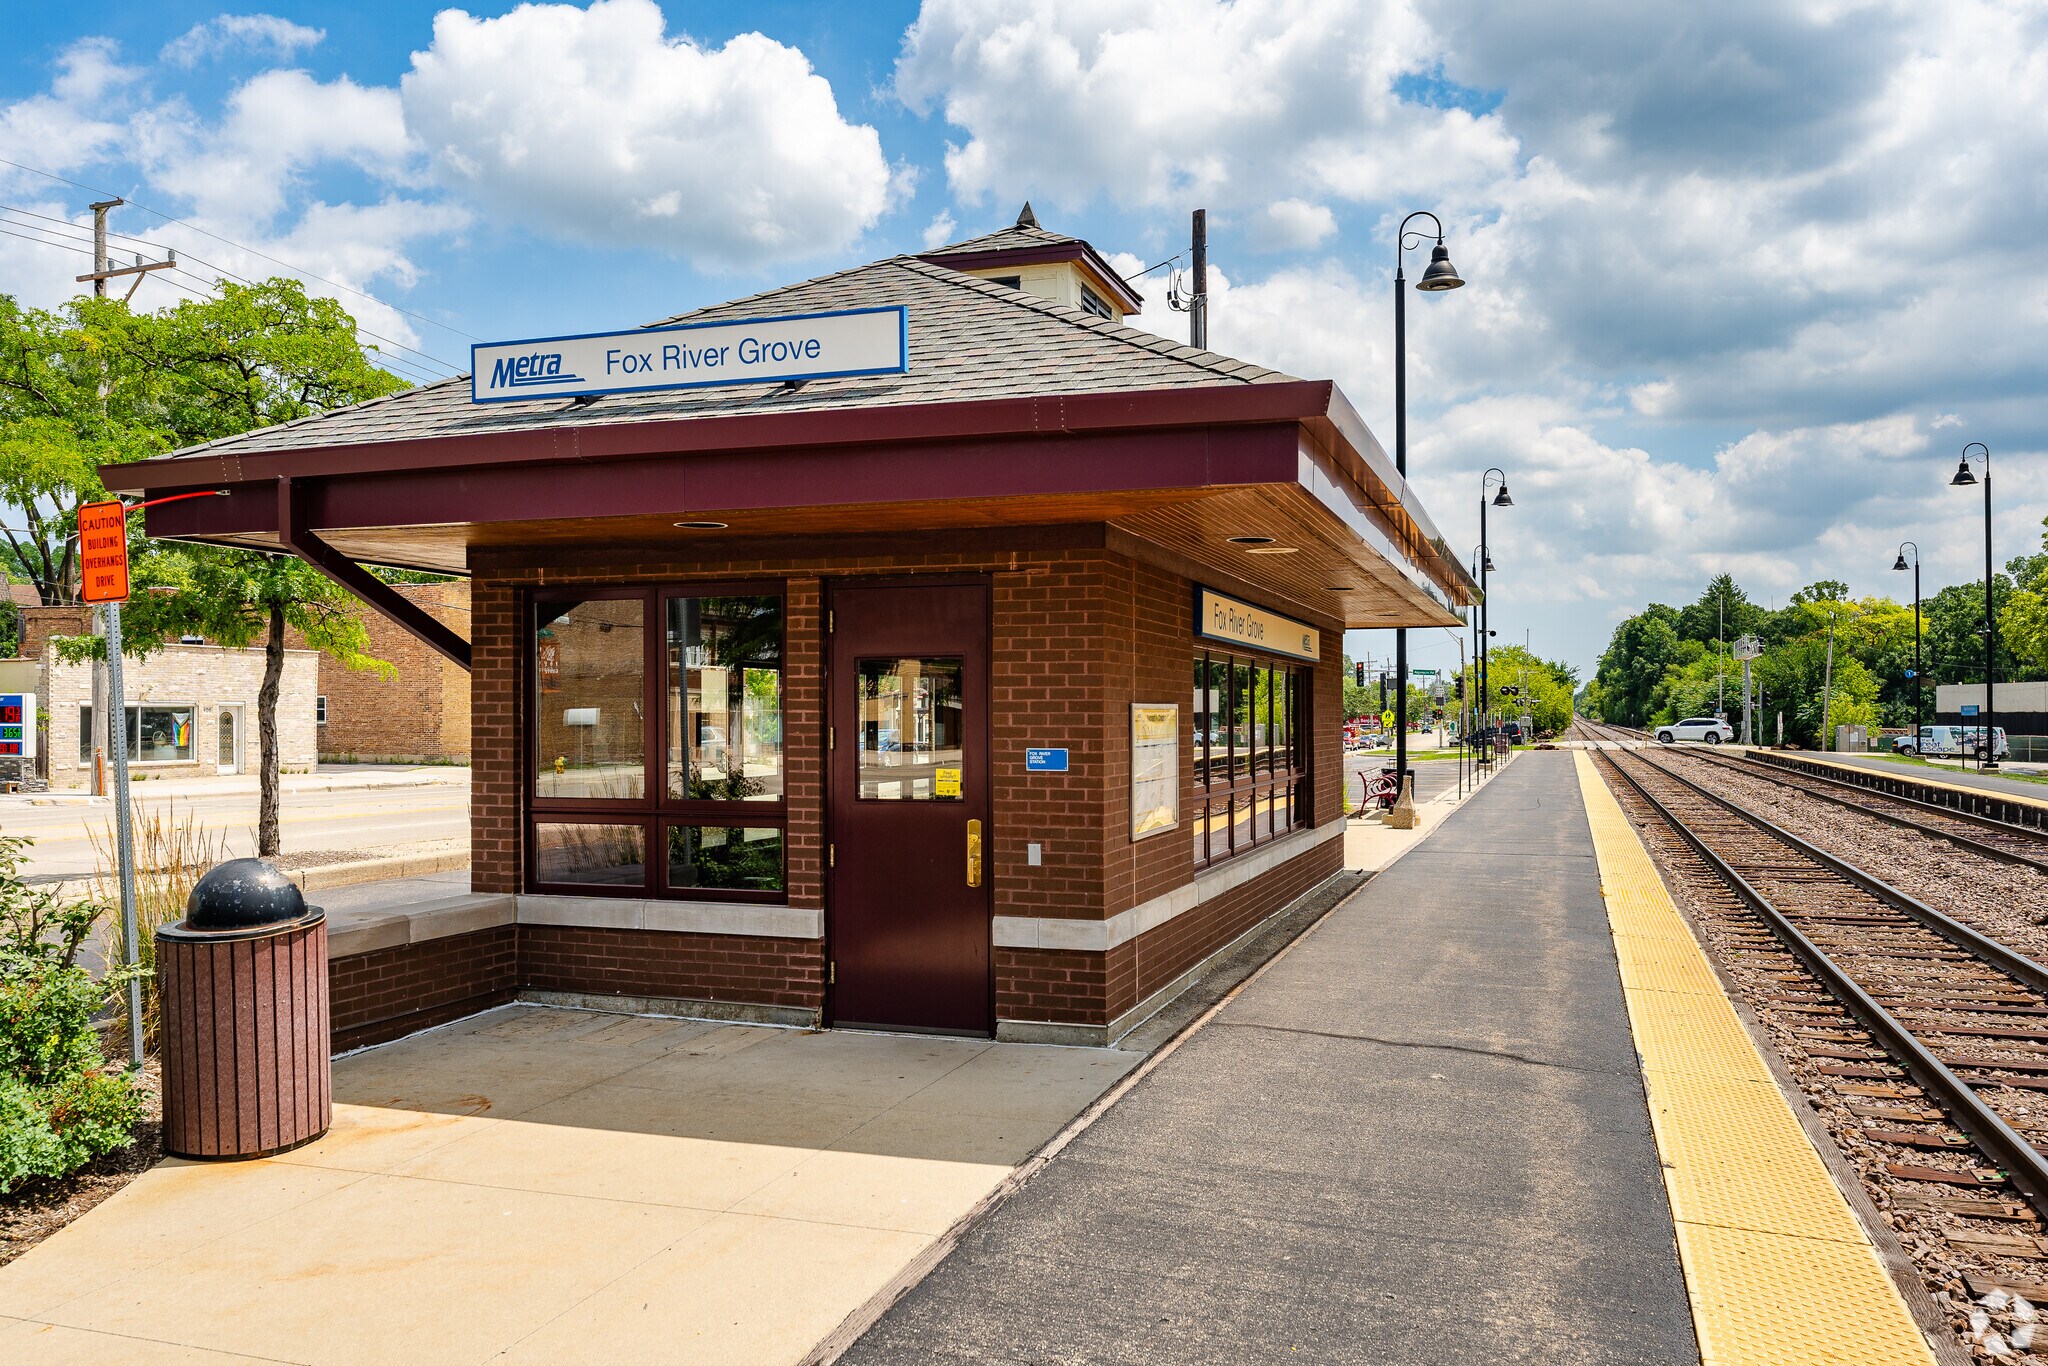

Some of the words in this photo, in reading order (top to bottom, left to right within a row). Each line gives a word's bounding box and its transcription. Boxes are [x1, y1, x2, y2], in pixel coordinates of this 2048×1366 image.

[490, 352, 564, 389] Metra
[606, 349, 653, 375] Fox
[663, 343, 729, 371] River
[738, 337, 821, 365] Grove
[82, 515, 122, 532] CAUTION
[87, 536, 118, 550] BUILDING
[85, 555, 123, 570] OVERHANGS
[95, 575, 115, 587] DRIVE
[1214, 602, 1227, 630] Fox
[1228, 607, 1246, 636] River
[1246, 614, 1264, 641] Grove
